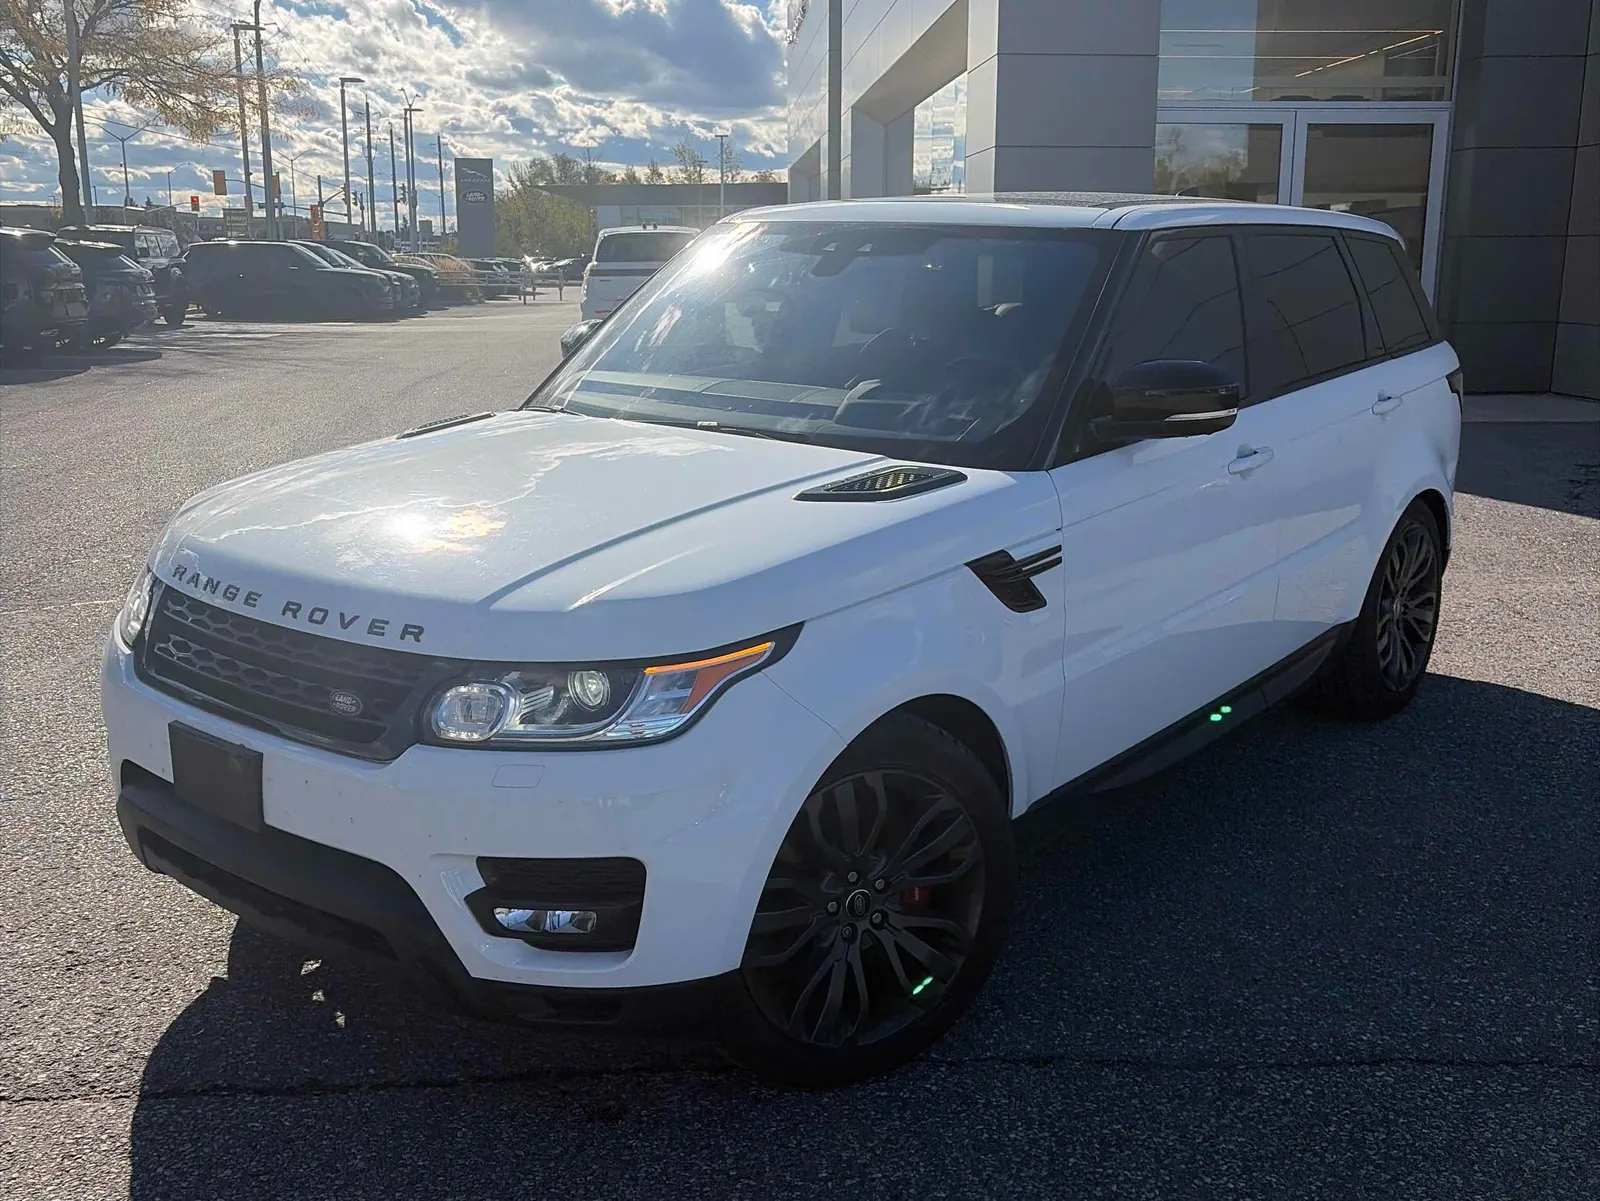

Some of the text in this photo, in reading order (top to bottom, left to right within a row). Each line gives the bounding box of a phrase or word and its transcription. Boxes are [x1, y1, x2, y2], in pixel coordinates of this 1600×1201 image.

[172, 564, 425, 643] RANGE ROVER
[335, 694, 352, 704] LAND
[335, 702, 356, 713] ROVER
